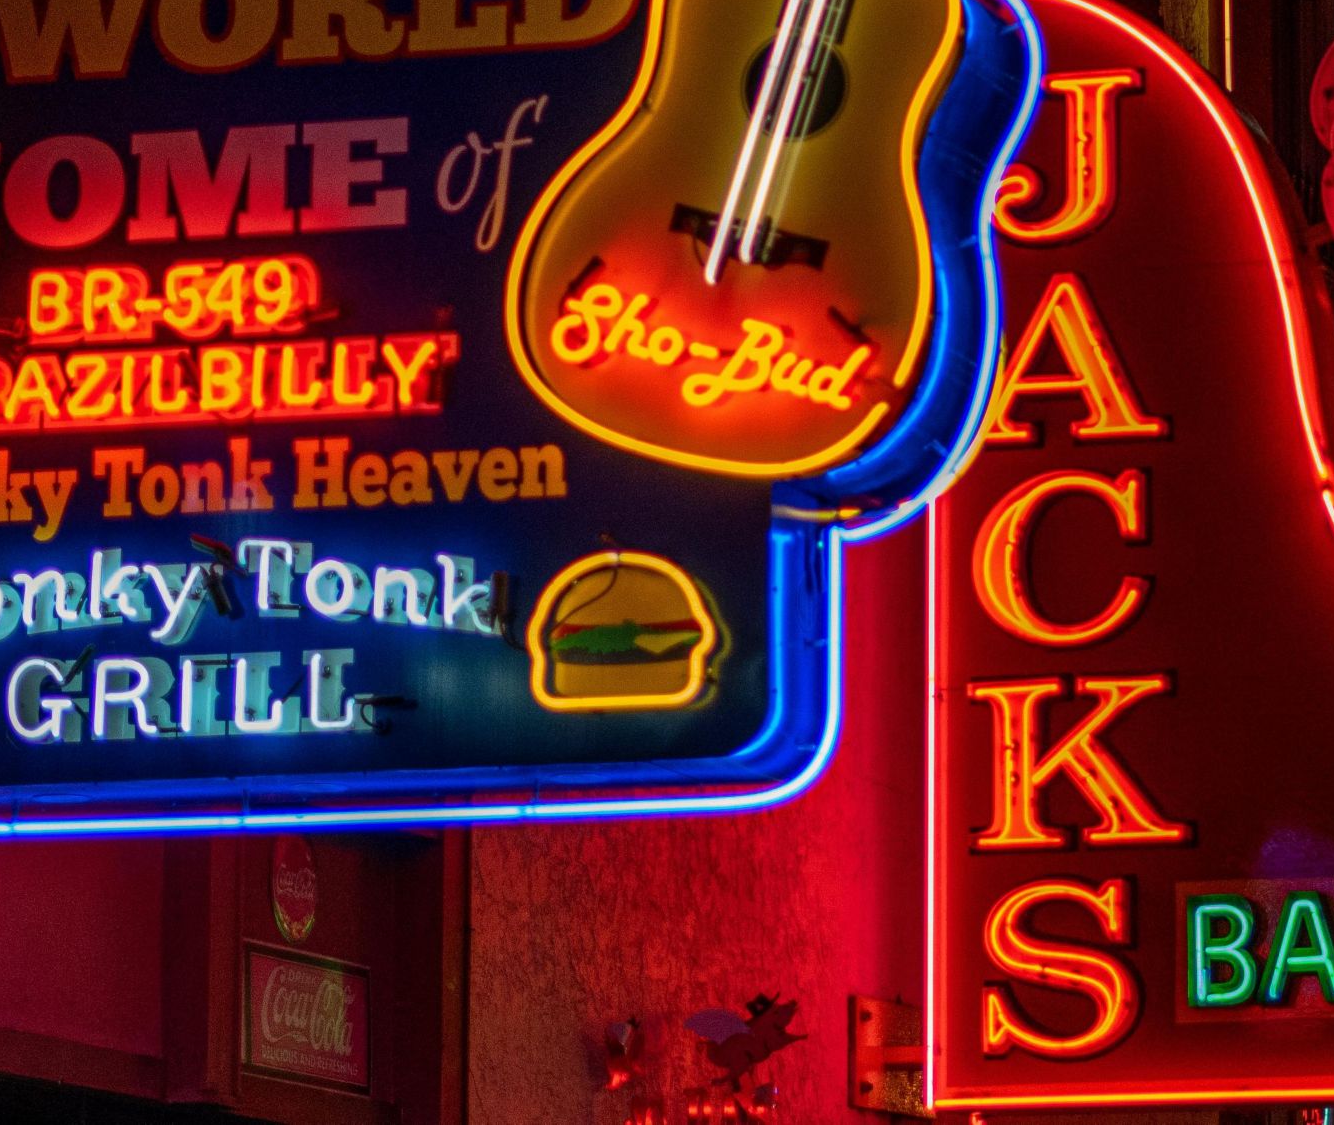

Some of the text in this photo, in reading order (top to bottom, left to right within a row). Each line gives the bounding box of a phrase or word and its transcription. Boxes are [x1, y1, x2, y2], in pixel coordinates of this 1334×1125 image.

[437, 95, 549, 252] of
[28, 256, 317, 344] BR-549
[550, 284, 871, 411] Sho-Bud
[93, 438, 274, 517] Tonk
[293, 436, 567, 509] Heaven
[236, 538, 507, 635] Tonk
[967, 67, 1194, 1061] JACKS
[6, 648, 375, 741] GRILL
